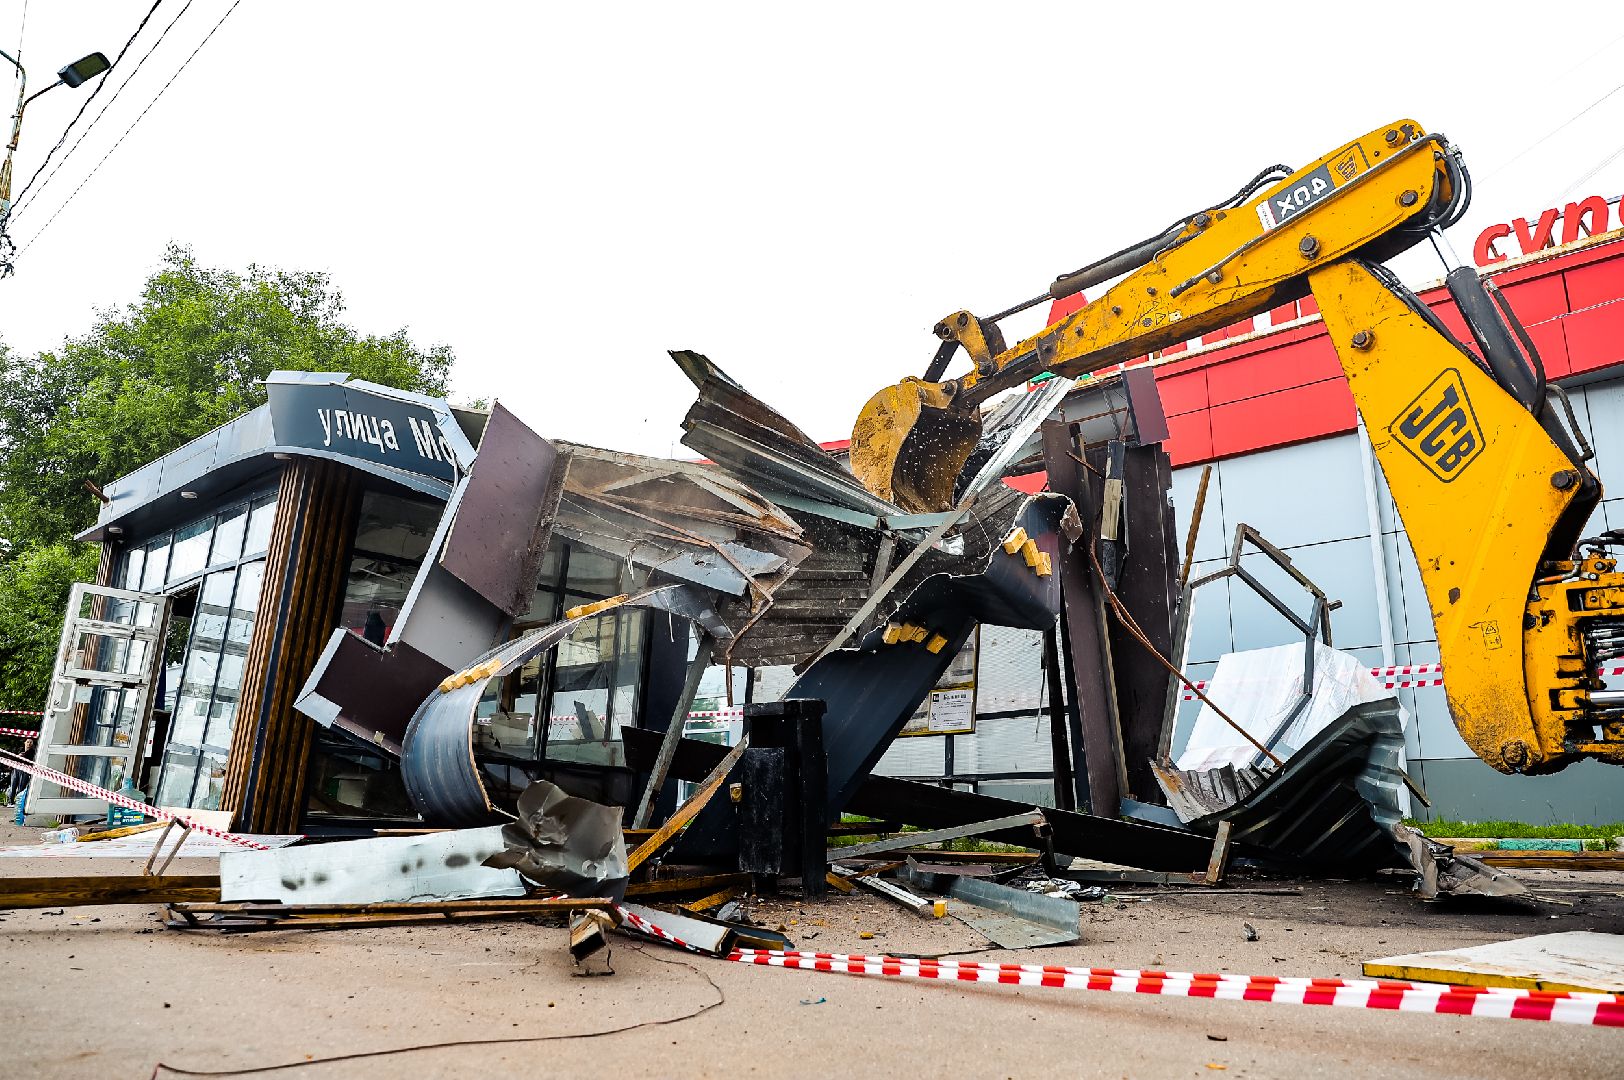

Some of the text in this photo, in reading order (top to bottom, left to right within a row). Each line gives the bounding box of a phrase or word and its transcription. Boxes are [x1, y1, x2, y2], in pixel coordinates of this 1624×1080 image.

[1276, 177, 1328, 218] 4CX
[1473, 194, 1624, 267] суп
[317, 408, 400, 454] улица
[1399, 383, 1476, 472] JCB
